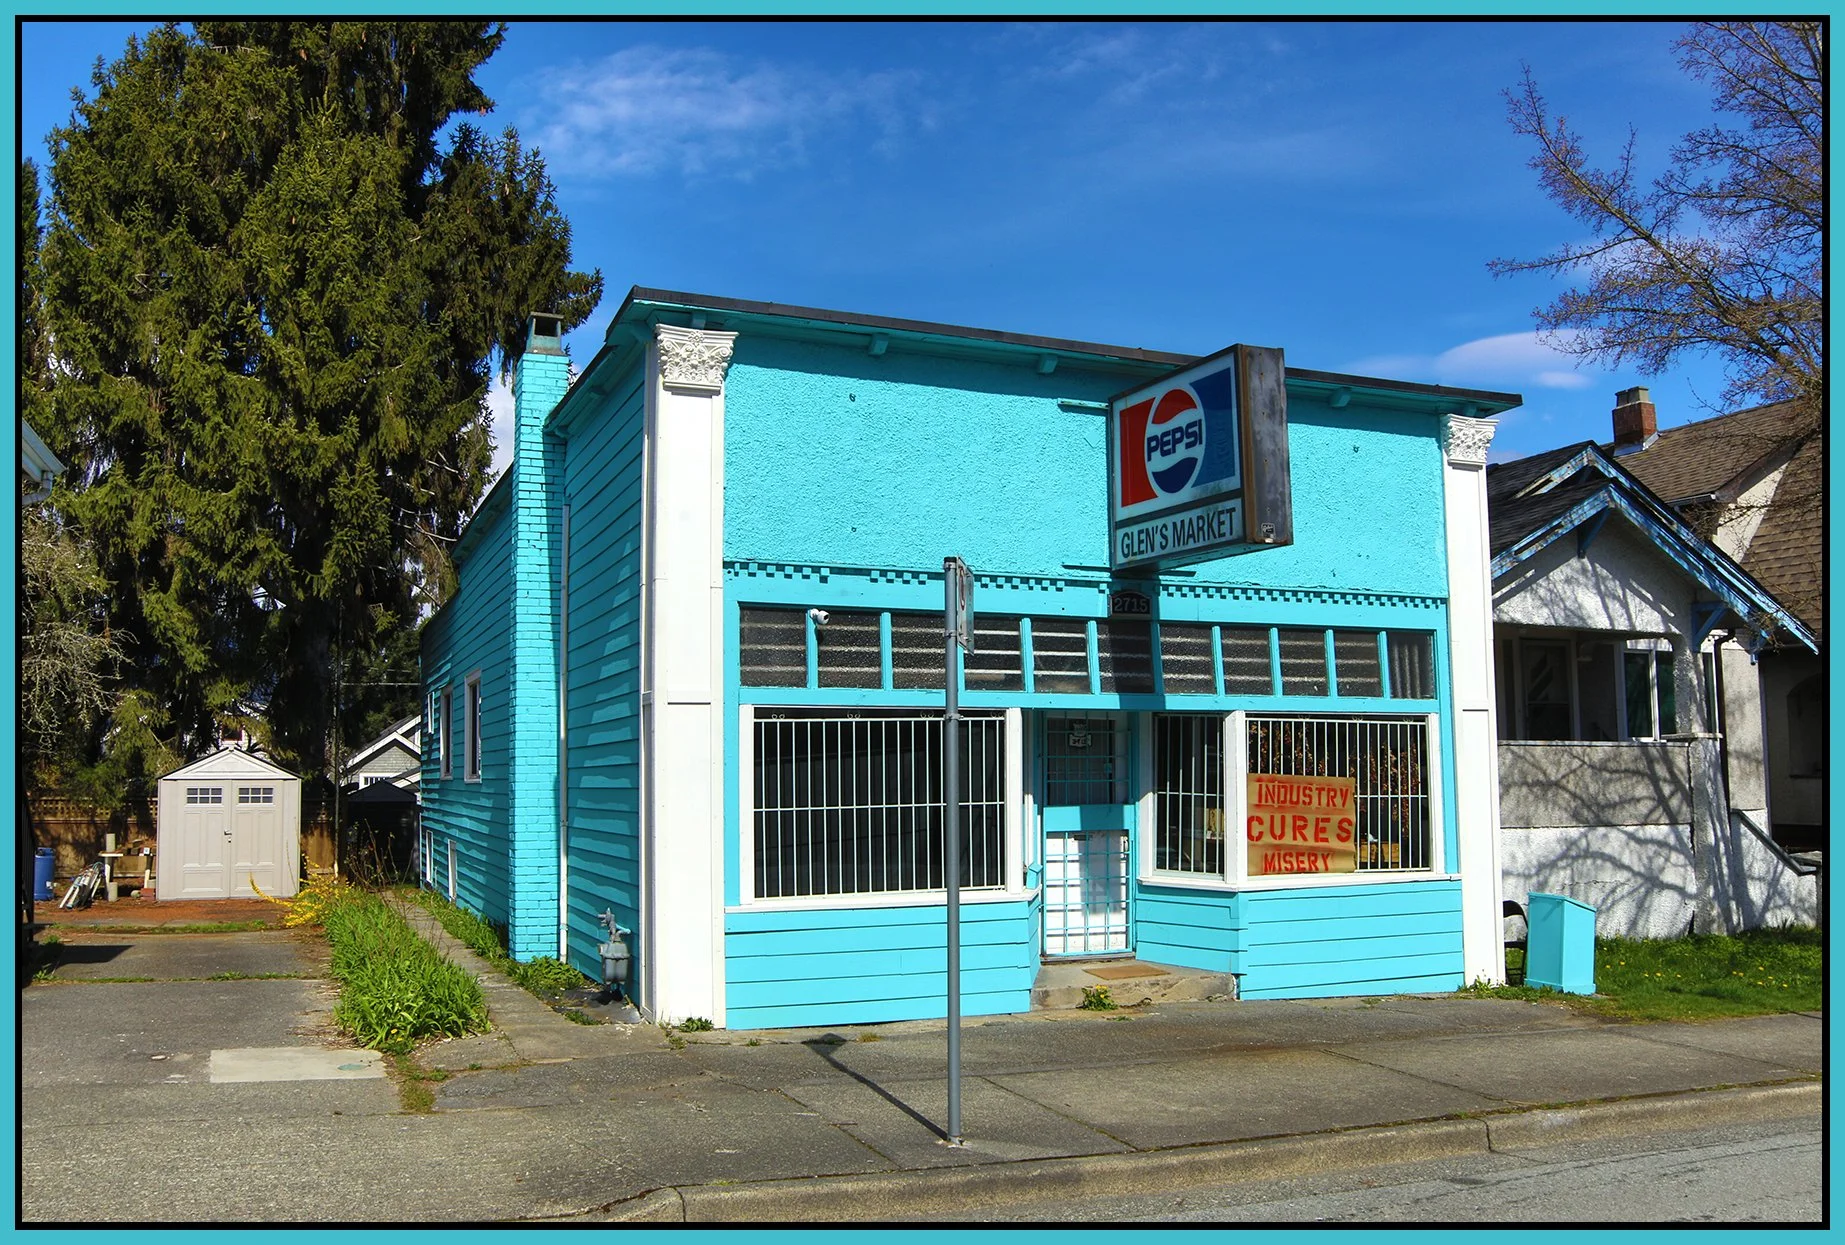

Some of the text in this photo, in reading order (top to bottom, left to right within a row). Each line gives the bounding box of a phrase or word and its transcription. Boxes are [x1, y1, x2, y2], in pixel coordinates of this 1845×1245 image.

[1147, 419, 1203, 462] PEPSI
[1121, 507, 1236, 559] GLEN'S MARKET
[1114, 596, 1148, 612] 2715
[1257, 783, 1349, 808] INDUSTRY
[1247, 814, 1353, 843] CURES
[1263, 851, 1330, 873] MISERY
